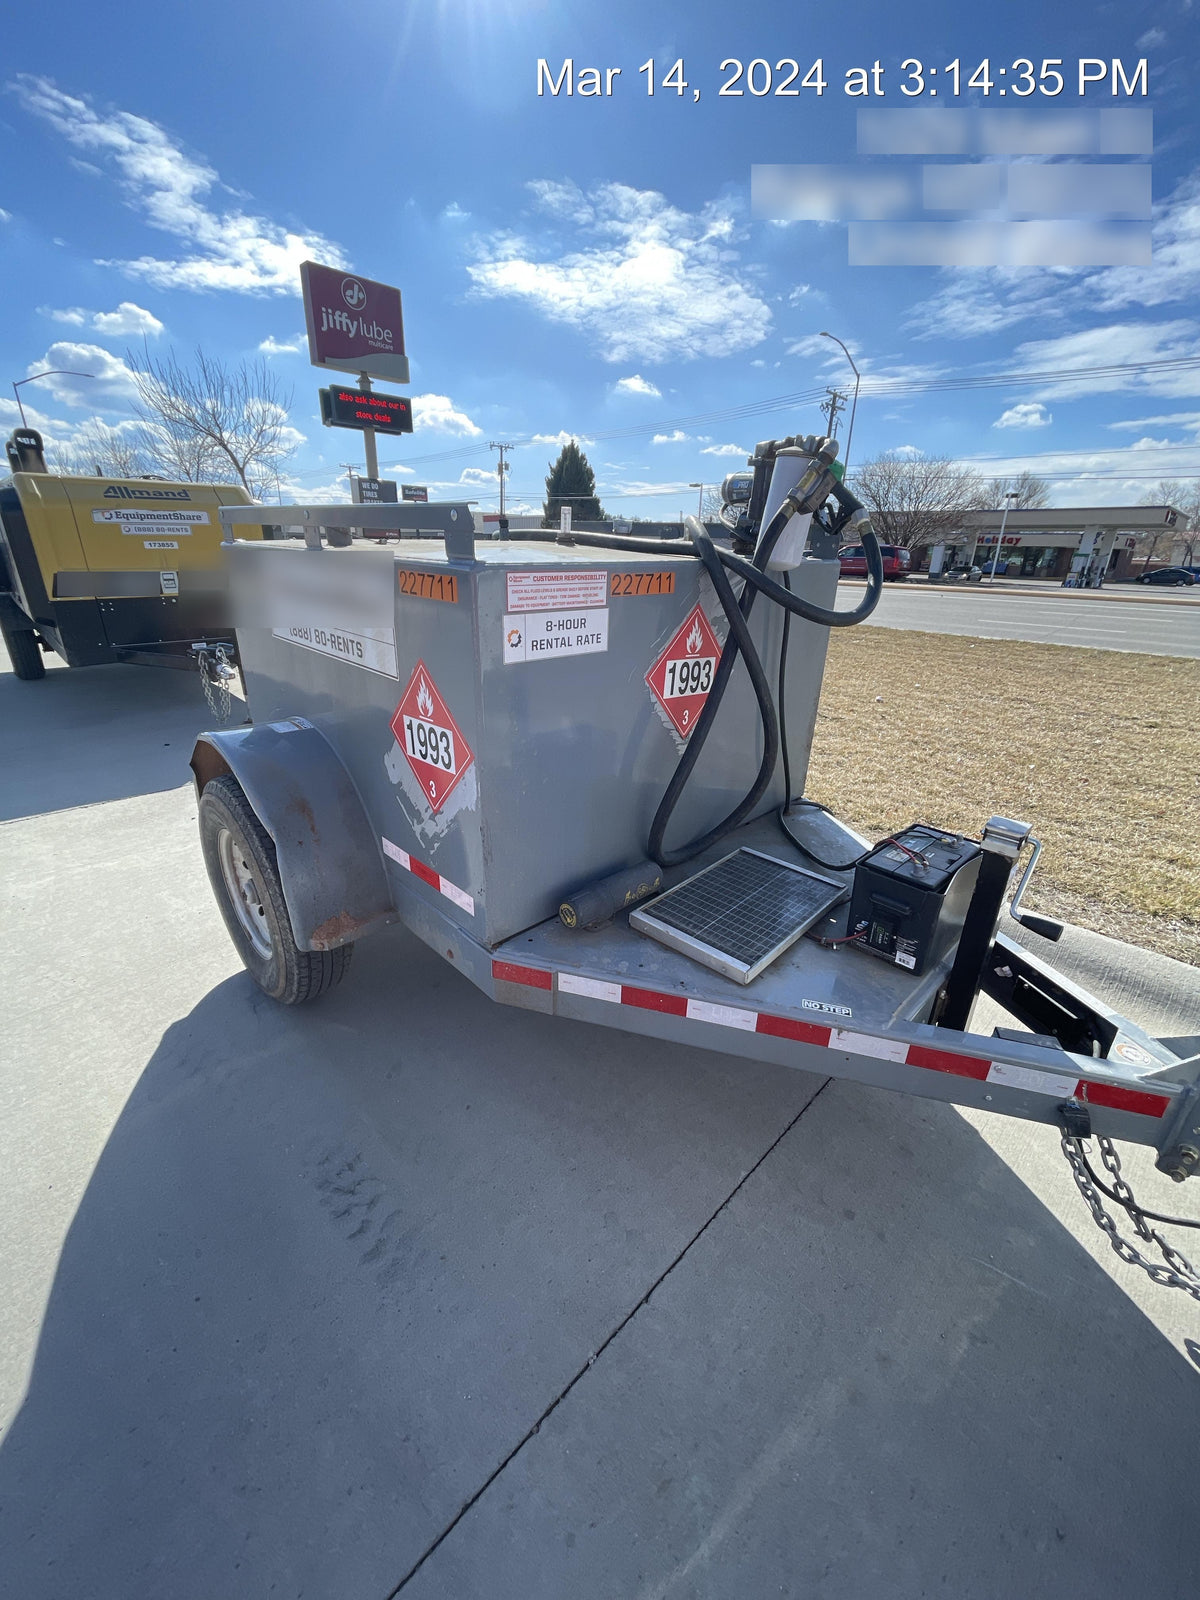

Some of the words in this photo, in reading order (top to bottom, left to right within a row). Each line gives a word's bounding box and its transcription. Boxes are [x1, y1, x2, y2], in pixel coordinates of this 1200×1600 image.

[321, 307, 357, 338] jiffy
[360, 317, 393, 343] lube
[368, 340, 393, 350] multicare
[339, 392, 353, 402] also
[355, 395, 368, 405] ask
[369, 397, 387, 408] about
[388, 402, 399, 410] our
[400, 401, 406, 411] in
[356, 410, 372, 420] store
[374, 412, 391, 422] deals
[104, 486, 190, 500] Allmand
[362, 482, 370, 490] WE
[371, 482, 379, 490] DO
[363, 490, 378, 498] TIRES
[115, 510, 201, 522] EquipmentShare
[400, 571, 455, 602] 227711
[564, 574, 606, 582] RESPONSIBILITY
[612, 572, 672, 597] 227711
[546, 618, 587, 632] 8-HOUR
[314, 629, 363, 659] 80-RENTS
[532, 636, 573, 651] RENTAL
[577, 633, 602, 645] RATE
[668, 659, 712, 696] 1993
[682, 709, 689, 726] 3
[406, 719, 452, 770] 1993
[429, 780, 437, 798] 3
[804, 1000, 820, 1009] NO
[821, 1004, 850, 1015] STEP
